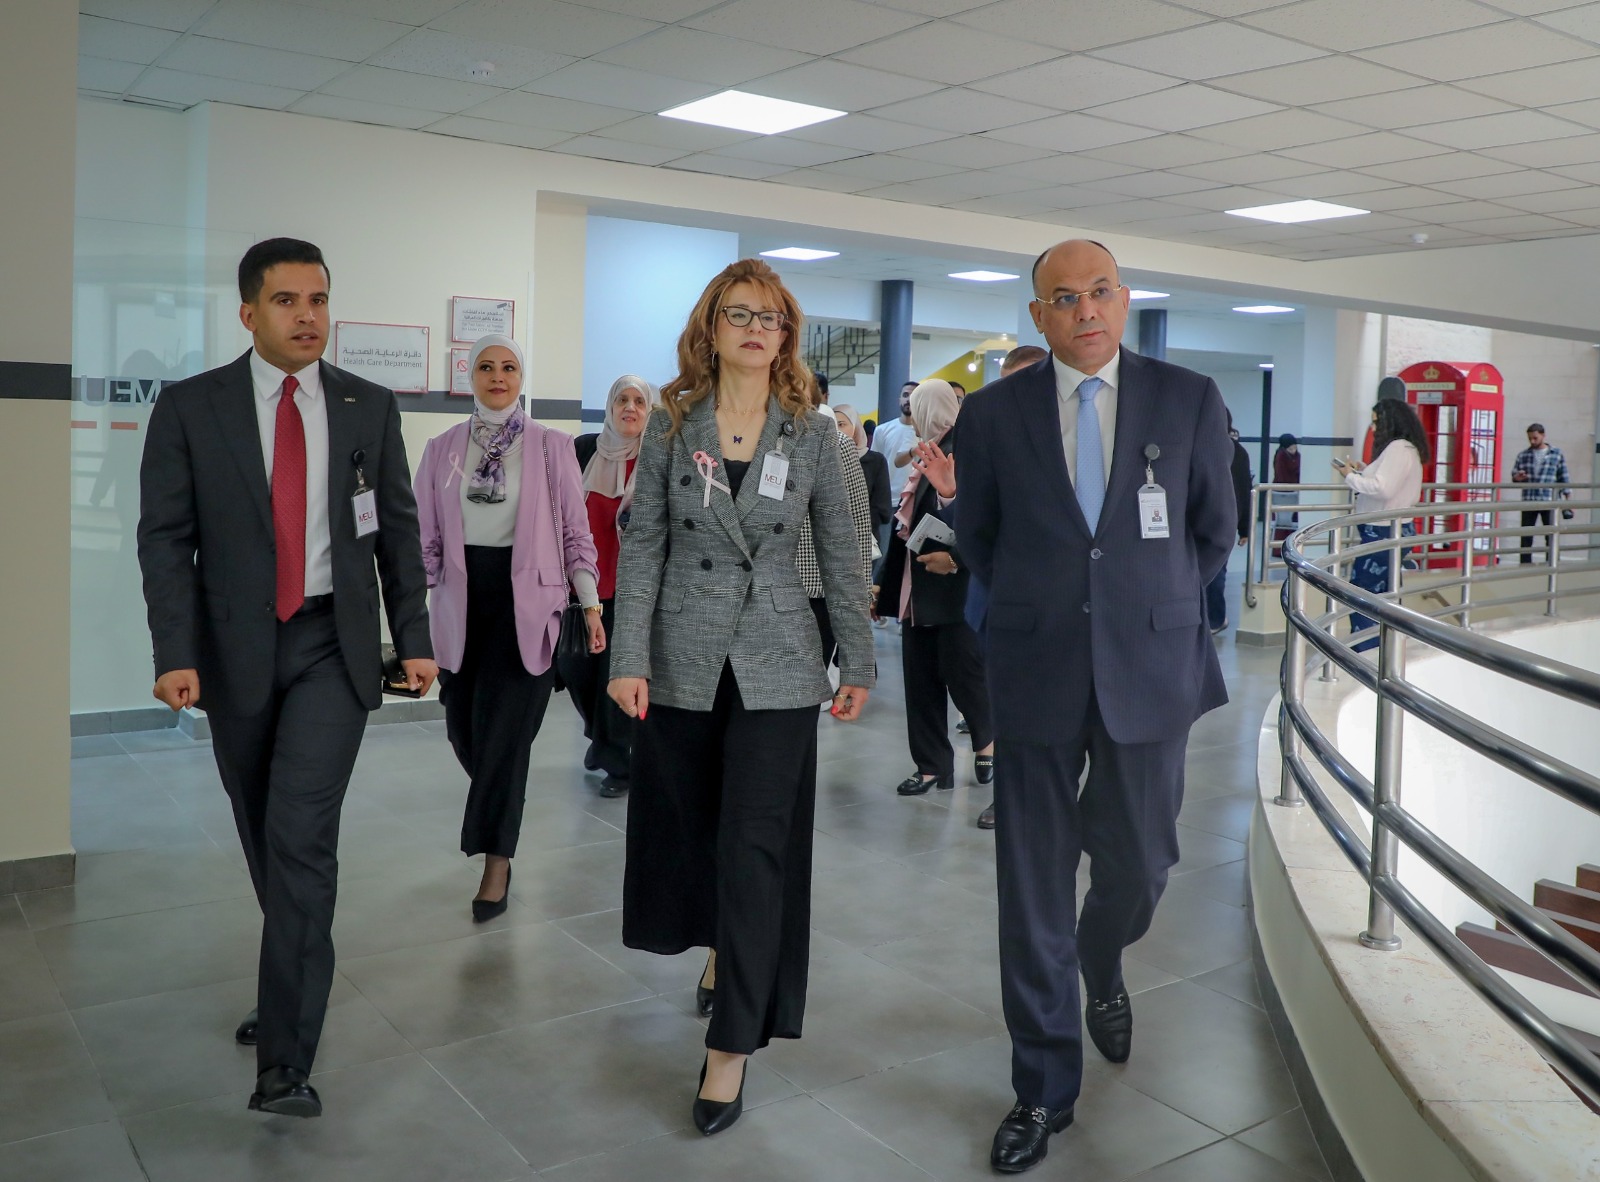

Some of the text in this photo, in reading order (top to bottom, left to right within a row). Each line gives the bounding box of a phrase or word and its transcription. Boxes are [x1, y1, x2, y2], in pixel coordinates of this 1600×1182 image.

[342, 347, 421, 359] دائرة الرعاية الصحية
[343, 357, 422, 368] Health Care Department
[765, 473, 782, 486] MEU
[359, 510, 373, 523] MEU
